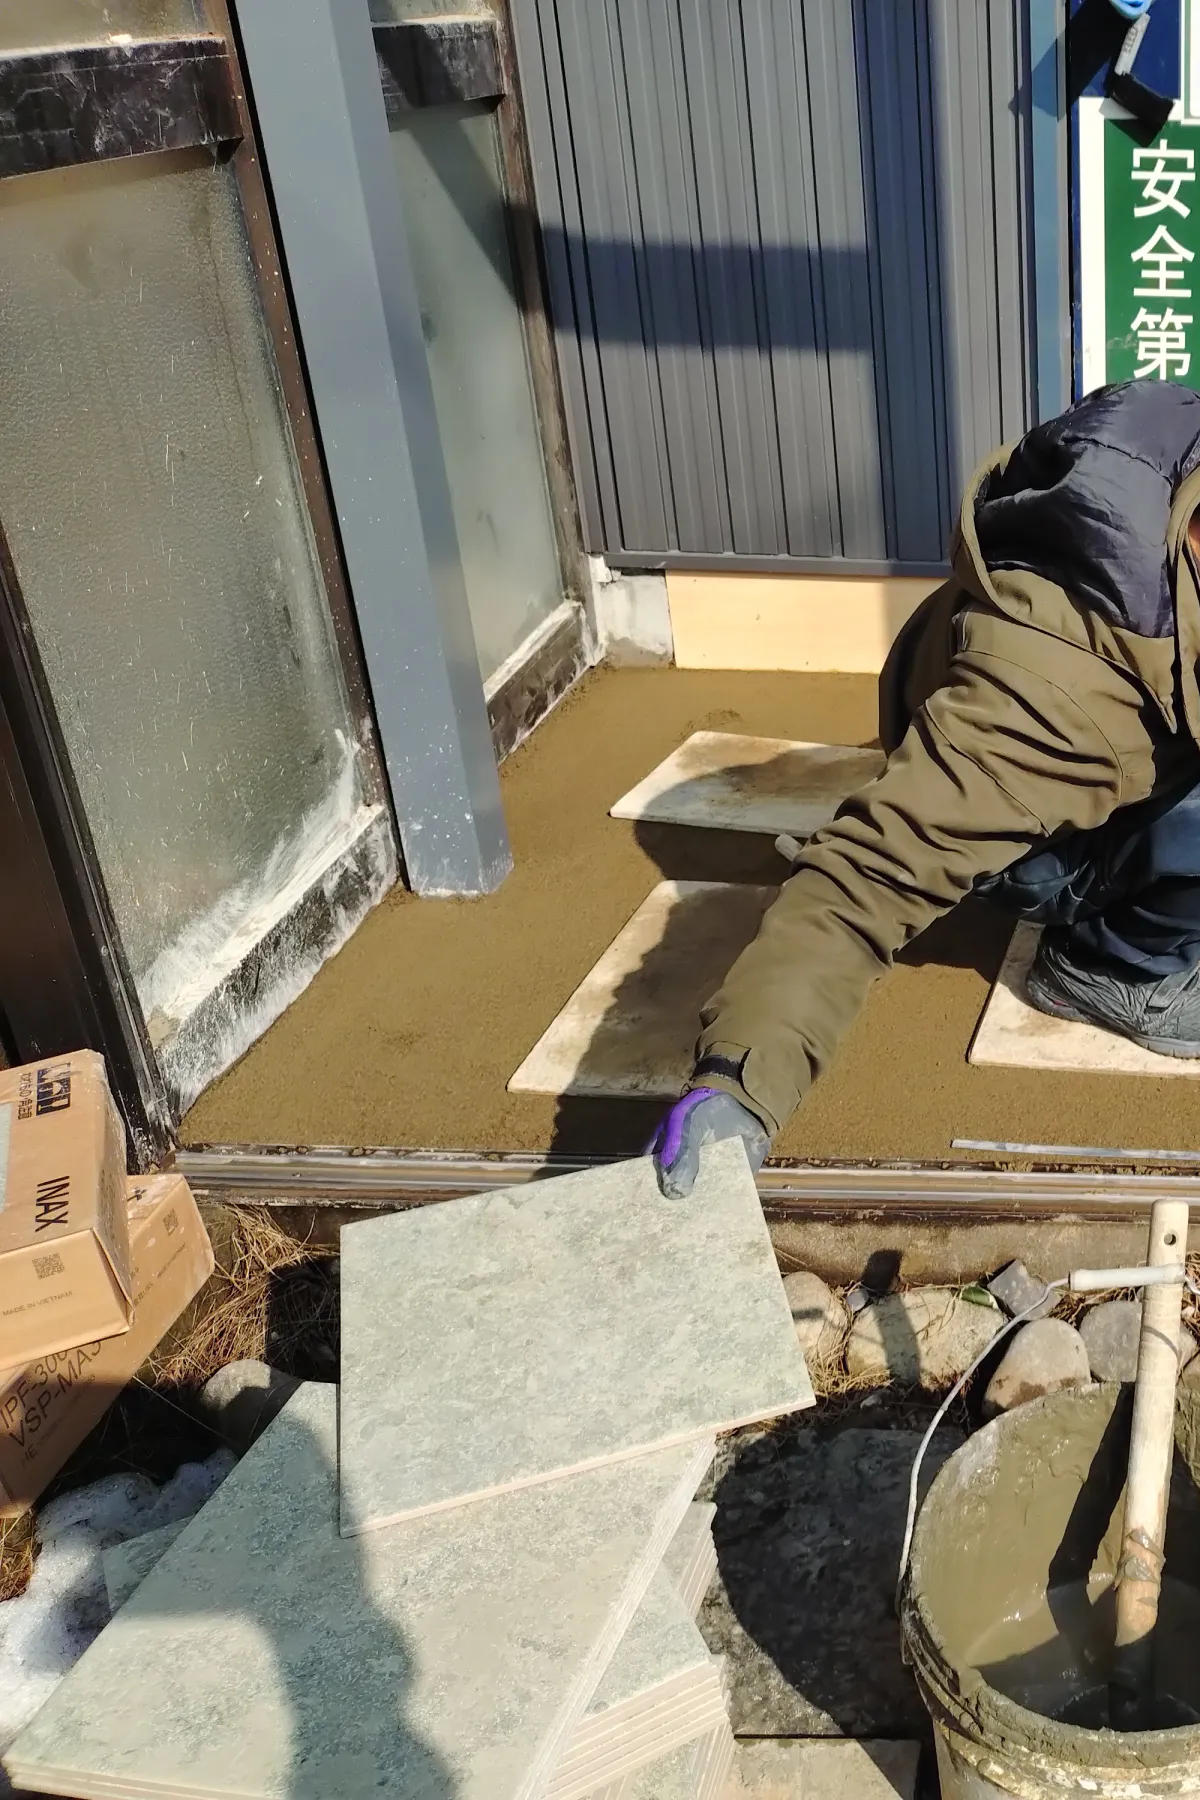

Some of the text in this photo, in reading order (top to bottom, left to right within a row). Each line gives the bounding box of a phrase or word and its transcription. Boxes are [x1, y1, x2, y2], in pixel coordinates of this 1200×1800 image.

[1130, 139, 1196, 381] 安全第
[35, 1175, 70, 1232] INAX
[2, 1305, 26, 1316] MADE
[36, 1290, 73, 1305] VIETNAM
